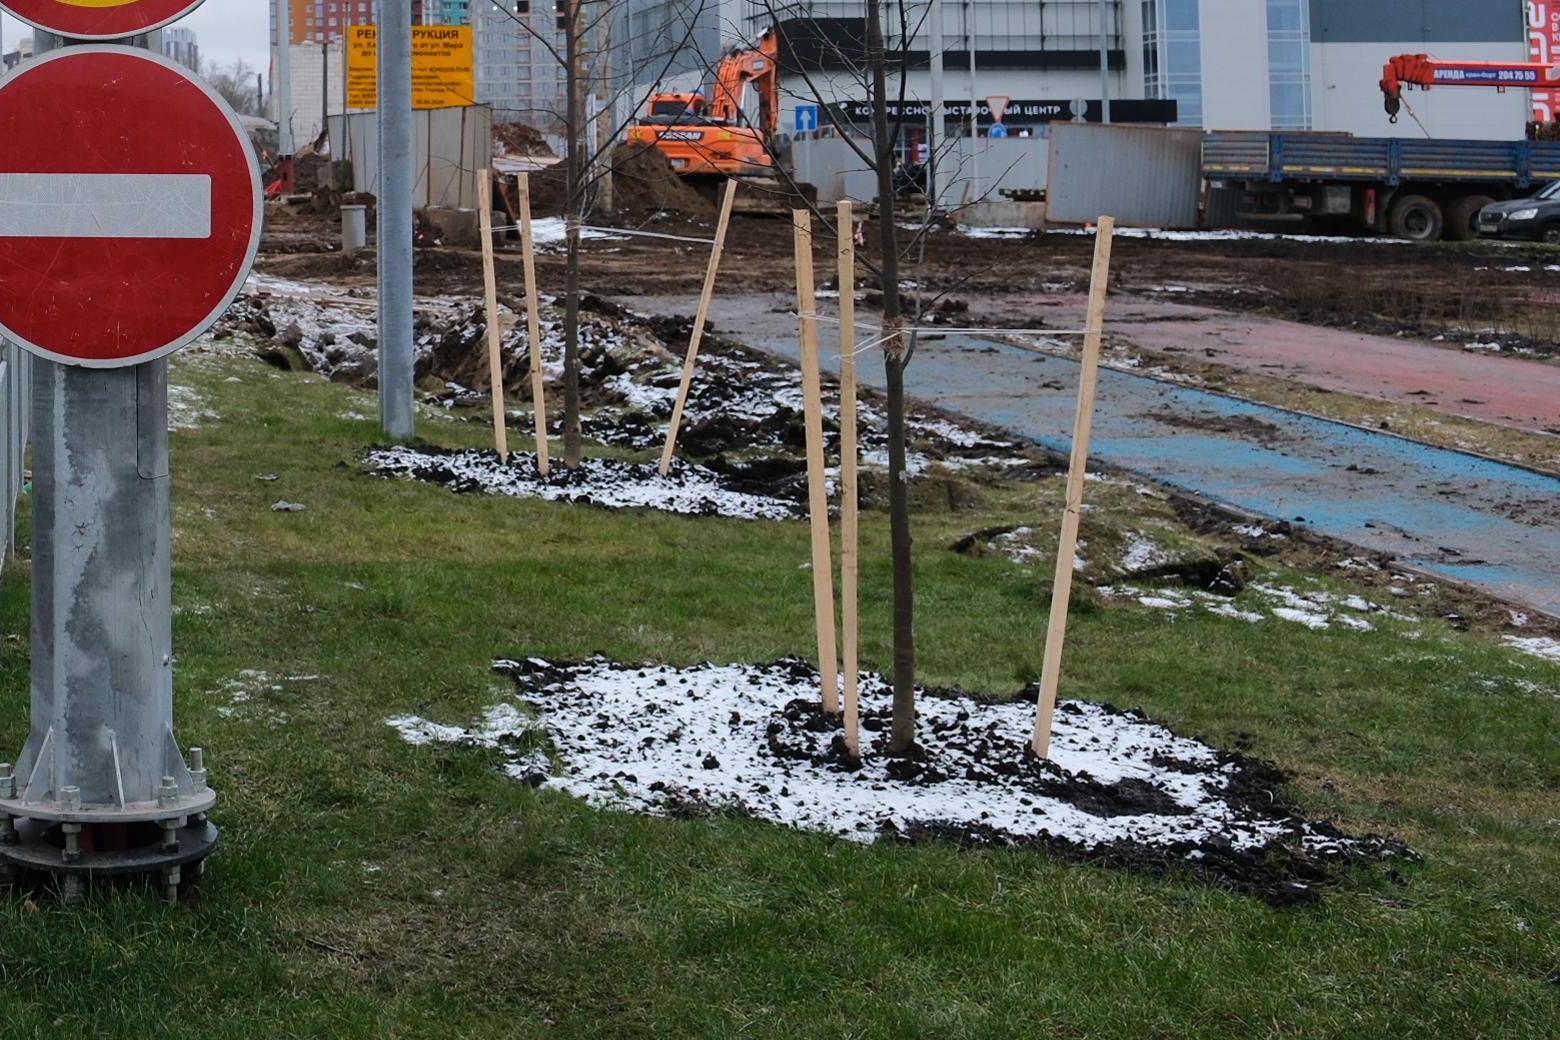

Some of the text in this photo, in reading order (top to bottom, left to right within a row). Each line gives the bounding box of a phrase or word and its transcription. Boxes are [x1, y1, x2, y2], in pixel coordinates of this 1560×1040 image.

[356, 29, 459, 40] РЕРУКЦИЯ
[1433, 69, 1465, 80] АРЕНДА
[1024, 106, 1061, 116] ЦЕНТР
